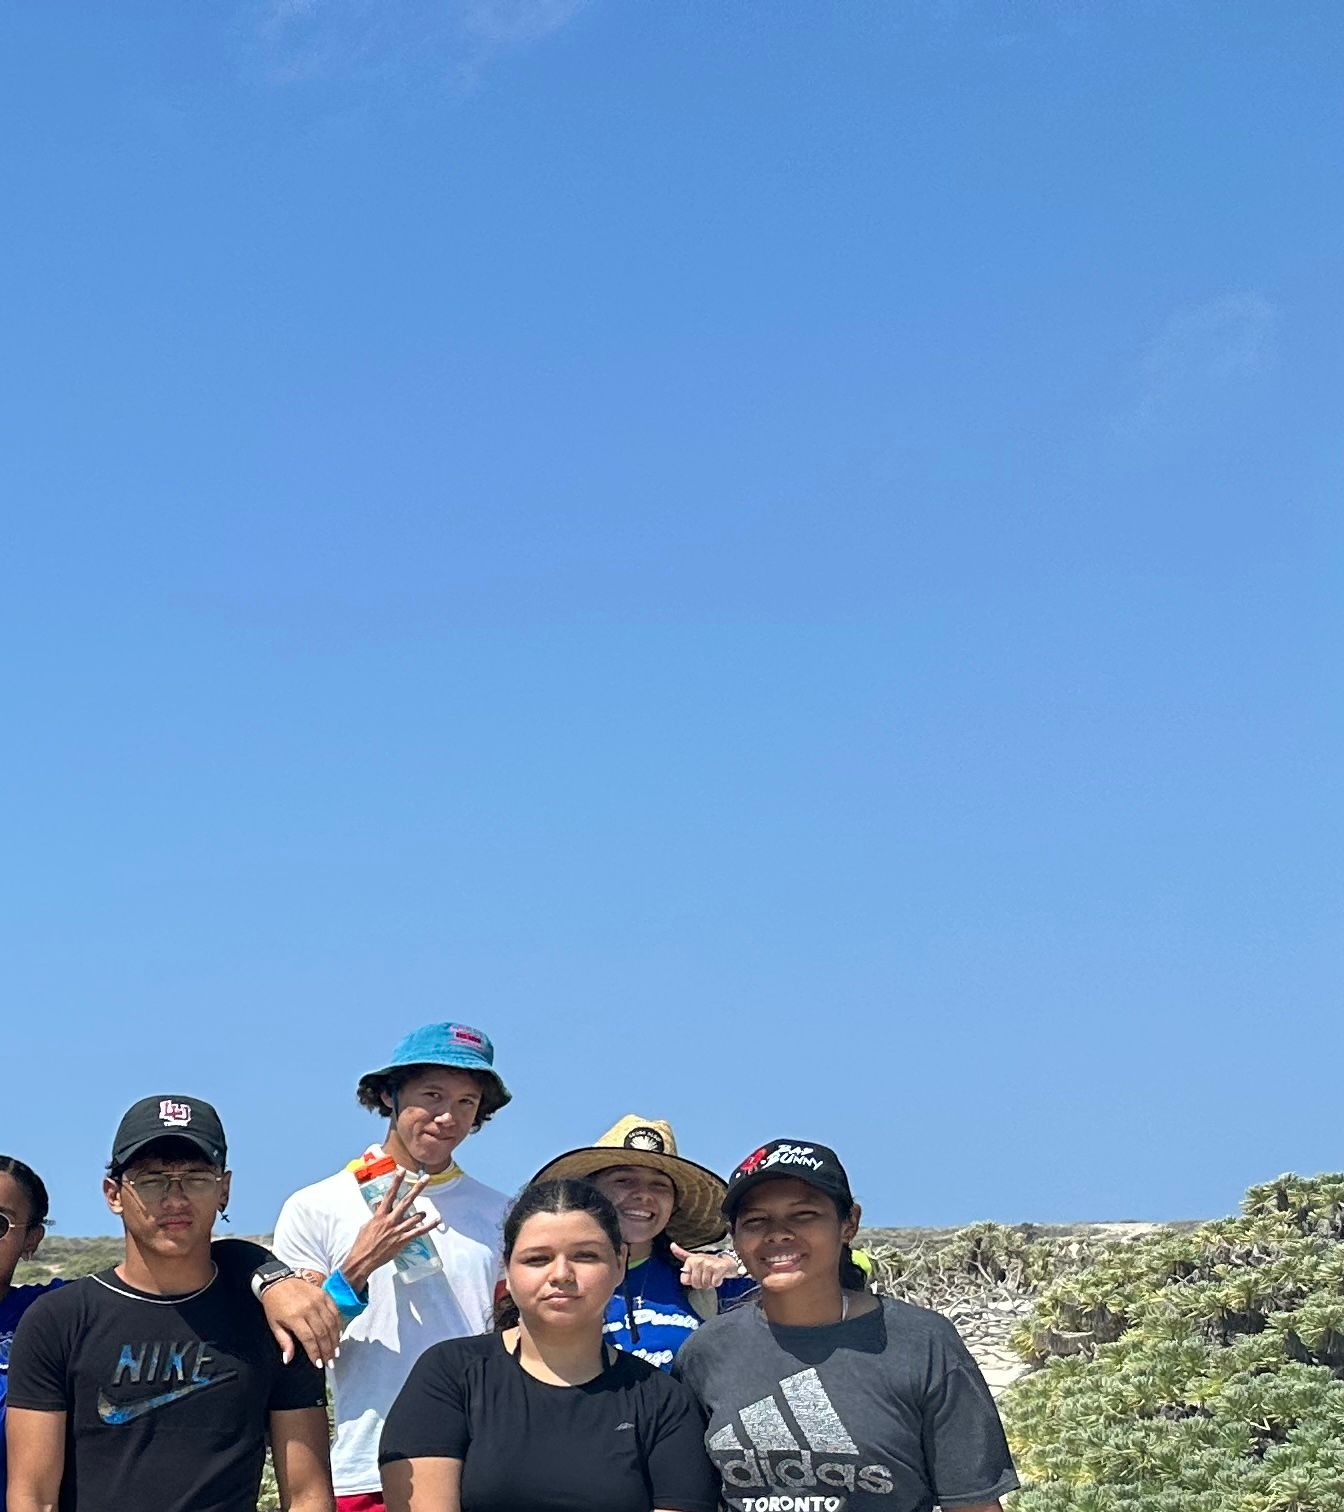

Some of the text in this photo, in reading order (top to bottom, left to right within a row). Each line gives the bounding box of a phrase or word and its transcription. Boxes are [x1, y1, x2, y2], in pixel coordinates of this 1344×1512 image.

[777, 1144, 814, 1156] BAD
[760, 1151, 824, 1171] BUNNY
[113, 1342, 217, 1385] NIKE
[715, 1449, 895, 1495] didas
[742, 1496, 841, 1512] TORONTO
